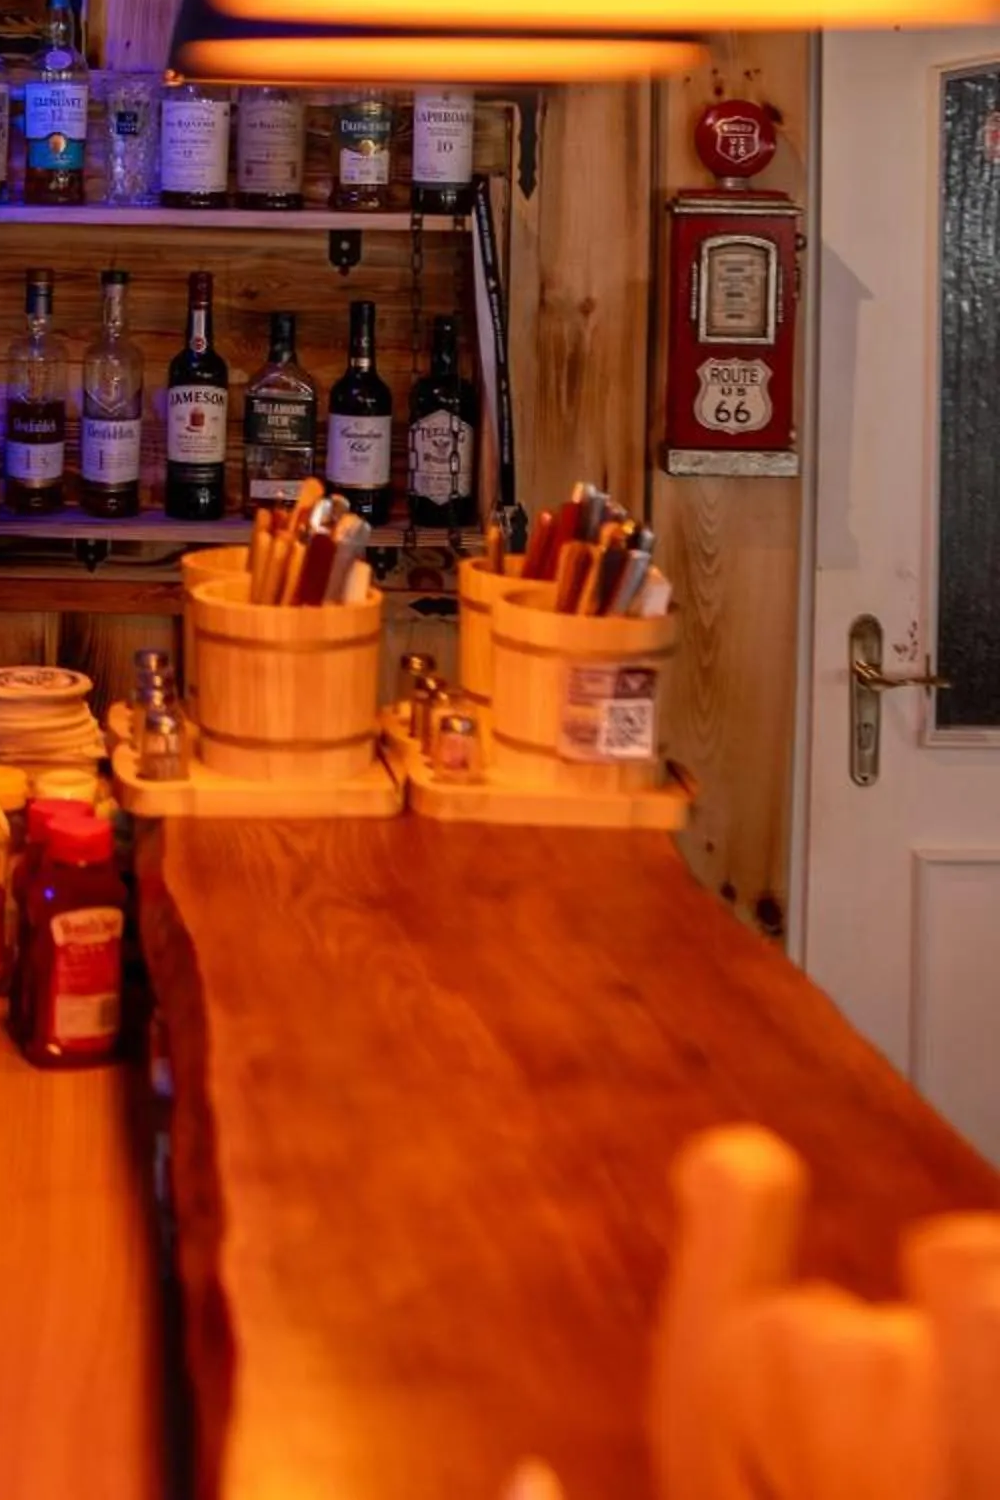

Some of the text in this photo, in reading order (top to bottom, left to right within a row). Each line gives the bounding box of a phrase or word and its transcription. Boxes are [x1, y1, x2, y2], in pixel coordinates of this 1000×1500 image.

[437, 140, 454, 153] 10
[710, 367, 759, 384] ROUTE
[170, 391, 225, 406] JAMESON
[715, 401, 752, 424] 66
